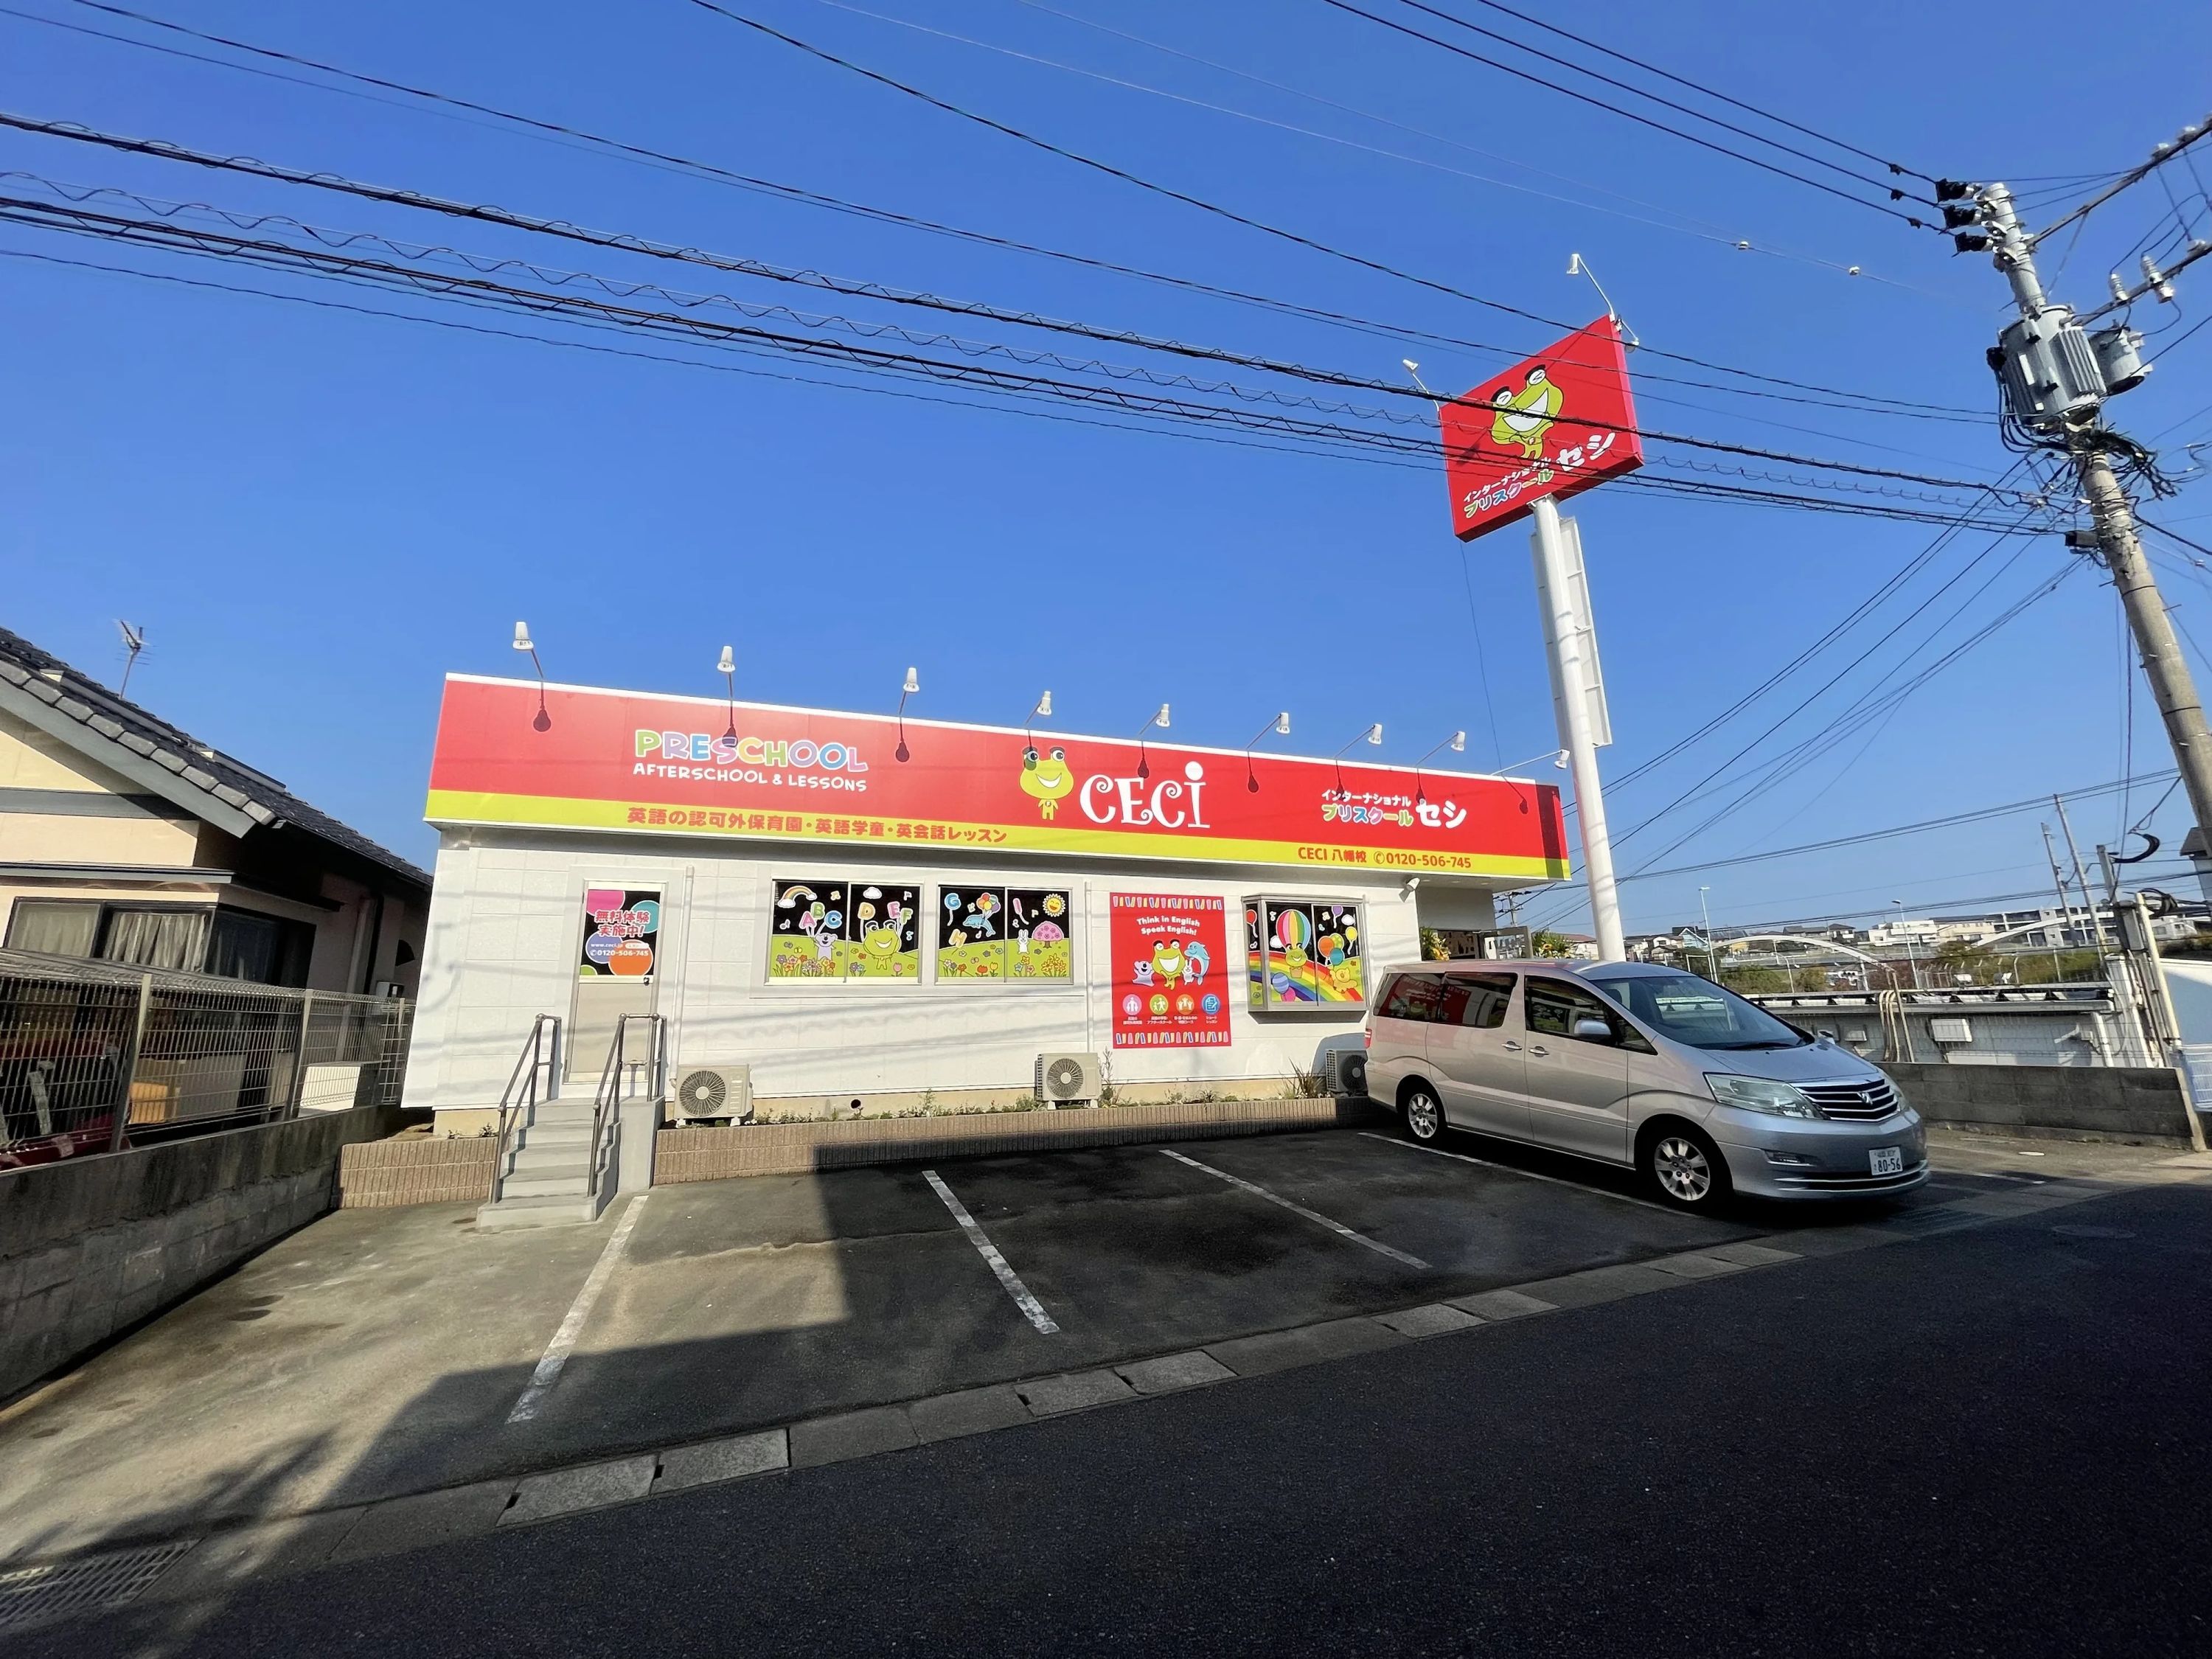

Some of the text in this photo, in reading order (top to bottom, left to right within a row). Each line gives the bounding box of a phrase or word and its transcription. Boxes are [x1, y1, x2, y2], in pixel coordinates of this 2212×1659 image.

[1556, 432, 1615, 472] セシ
[1464, 469, 1555, 518] プリスクール
[634, 728, 869, 772] PRESCHOOL
[633, 762, 868, 792] AFTERSCHOOL & LESSONS
[1321, 789, 1411, 807] インターナショナル
[1321, 804, 1413, 827] プリスクール
[1415, 799, 1467, 829] セシ
[1298, 846, 1472, 869] CECI 八幡校 0120-506-745
[810, 901, 825, 920] B
[858, 902, 876, 920] D
[887, 901, 901, 919] E
[945, 893, 961, 911] G
[594, 909, 650, 924] 無料体験
[799, 911, 817, 929] A
[824, 910, 843, 929] C
[900, 908, 914, 925] F
[1136, 916, 1160, 925] Think
[1171, 916, 1200, 927] English
[1141, 925, 1197, 936] Speak English!
[1877, 1158, 1901, 1172] 80-56
